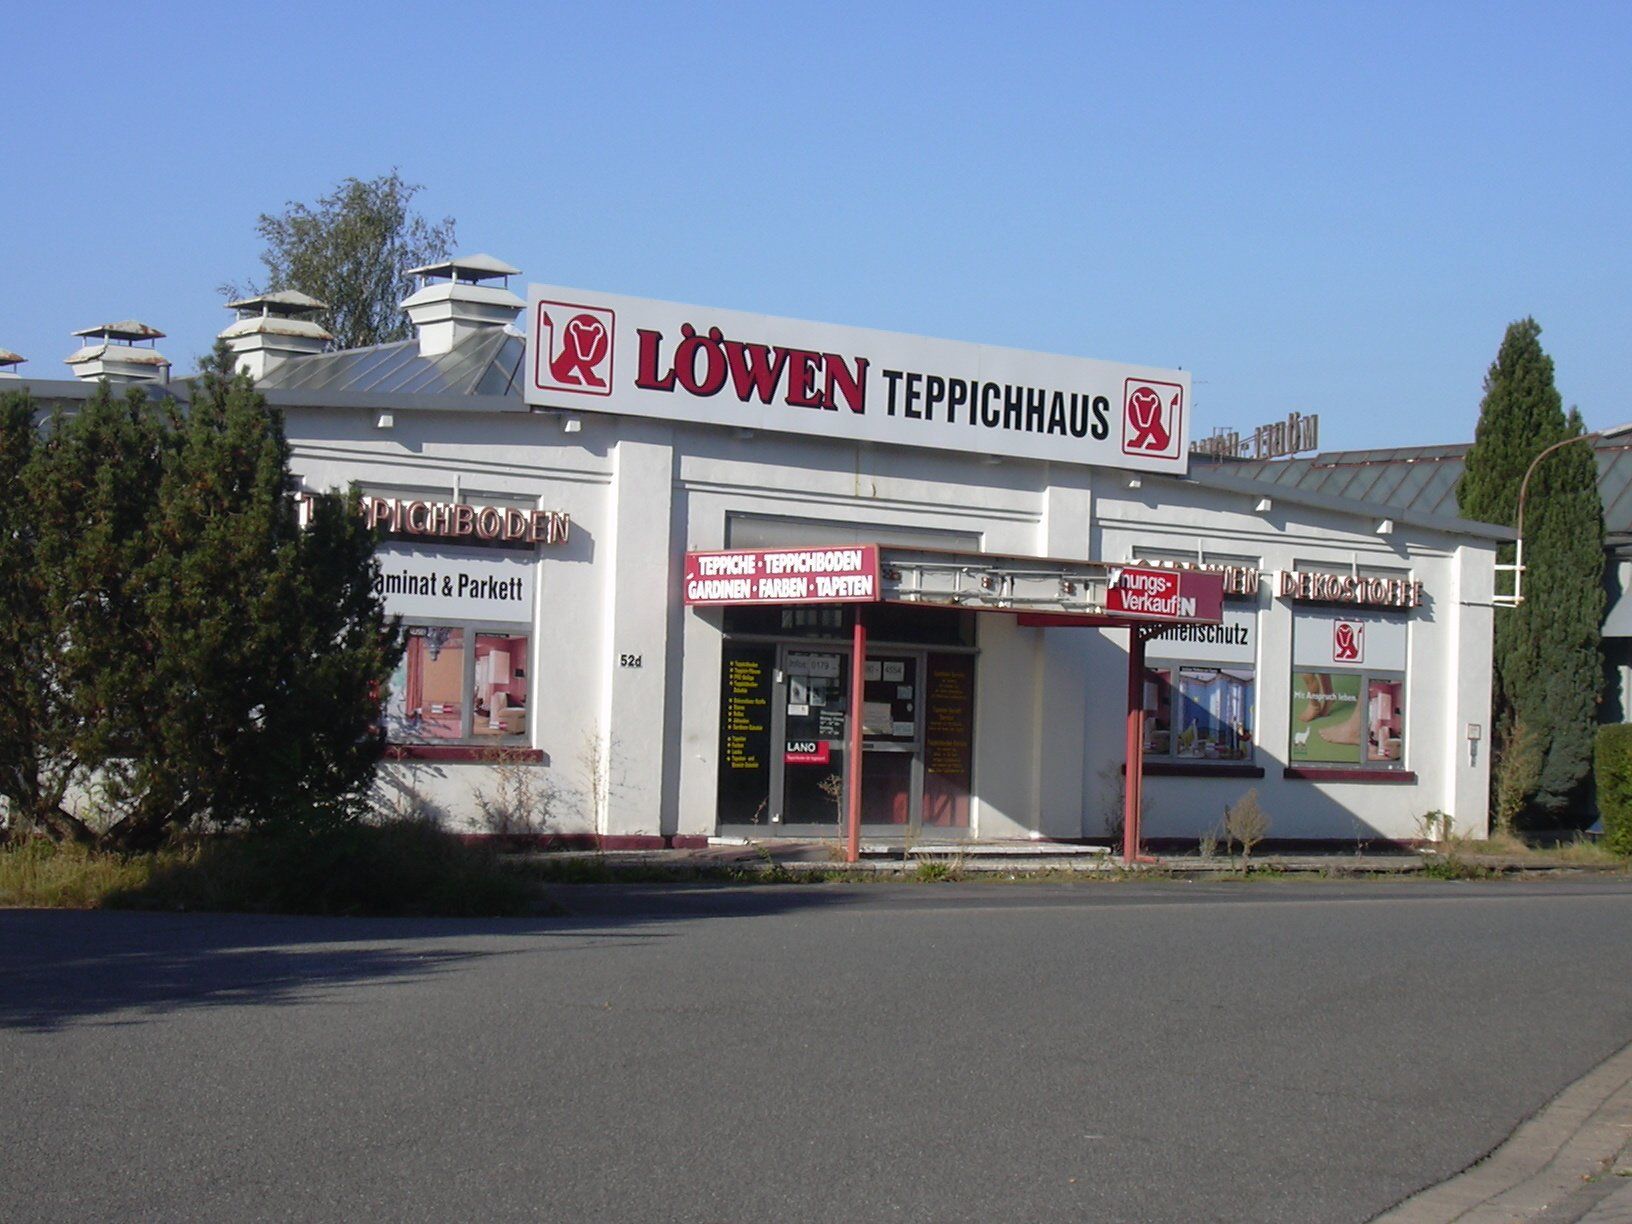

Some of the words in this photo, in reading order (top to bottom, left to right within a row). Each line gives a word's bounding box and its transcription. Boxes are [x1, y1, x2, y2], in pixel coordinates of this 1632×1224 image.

[635, 322, 870, 414] LÖWEN
[882, 369, 1110, 441] TEPPICHHAUS
[297, 493, 571, 544] TPICHBODEN
[698, 554, 756, 576] TEPPICHE
[763, 550, 862, 574] TEPPICHBODEN
[374, 569, 437, 597] aminat
[441, 575, 453, 598] &
[457, 573, 523, 601] Parkett
[688, 578, 751, 600] GARDINEN
[758, 577, 808, 599] FARBEN
[815, 575, 874, 597] TAPETEN
[1277, 569, 1424, 608] DEKOSTOFFE
[1121, 590, 1178, 616] Verkauf
[1144, 622, 1249, 646] nenschutz
[620, 654, 642, 668] 52d
[787, 741, 817, 753] LANO
